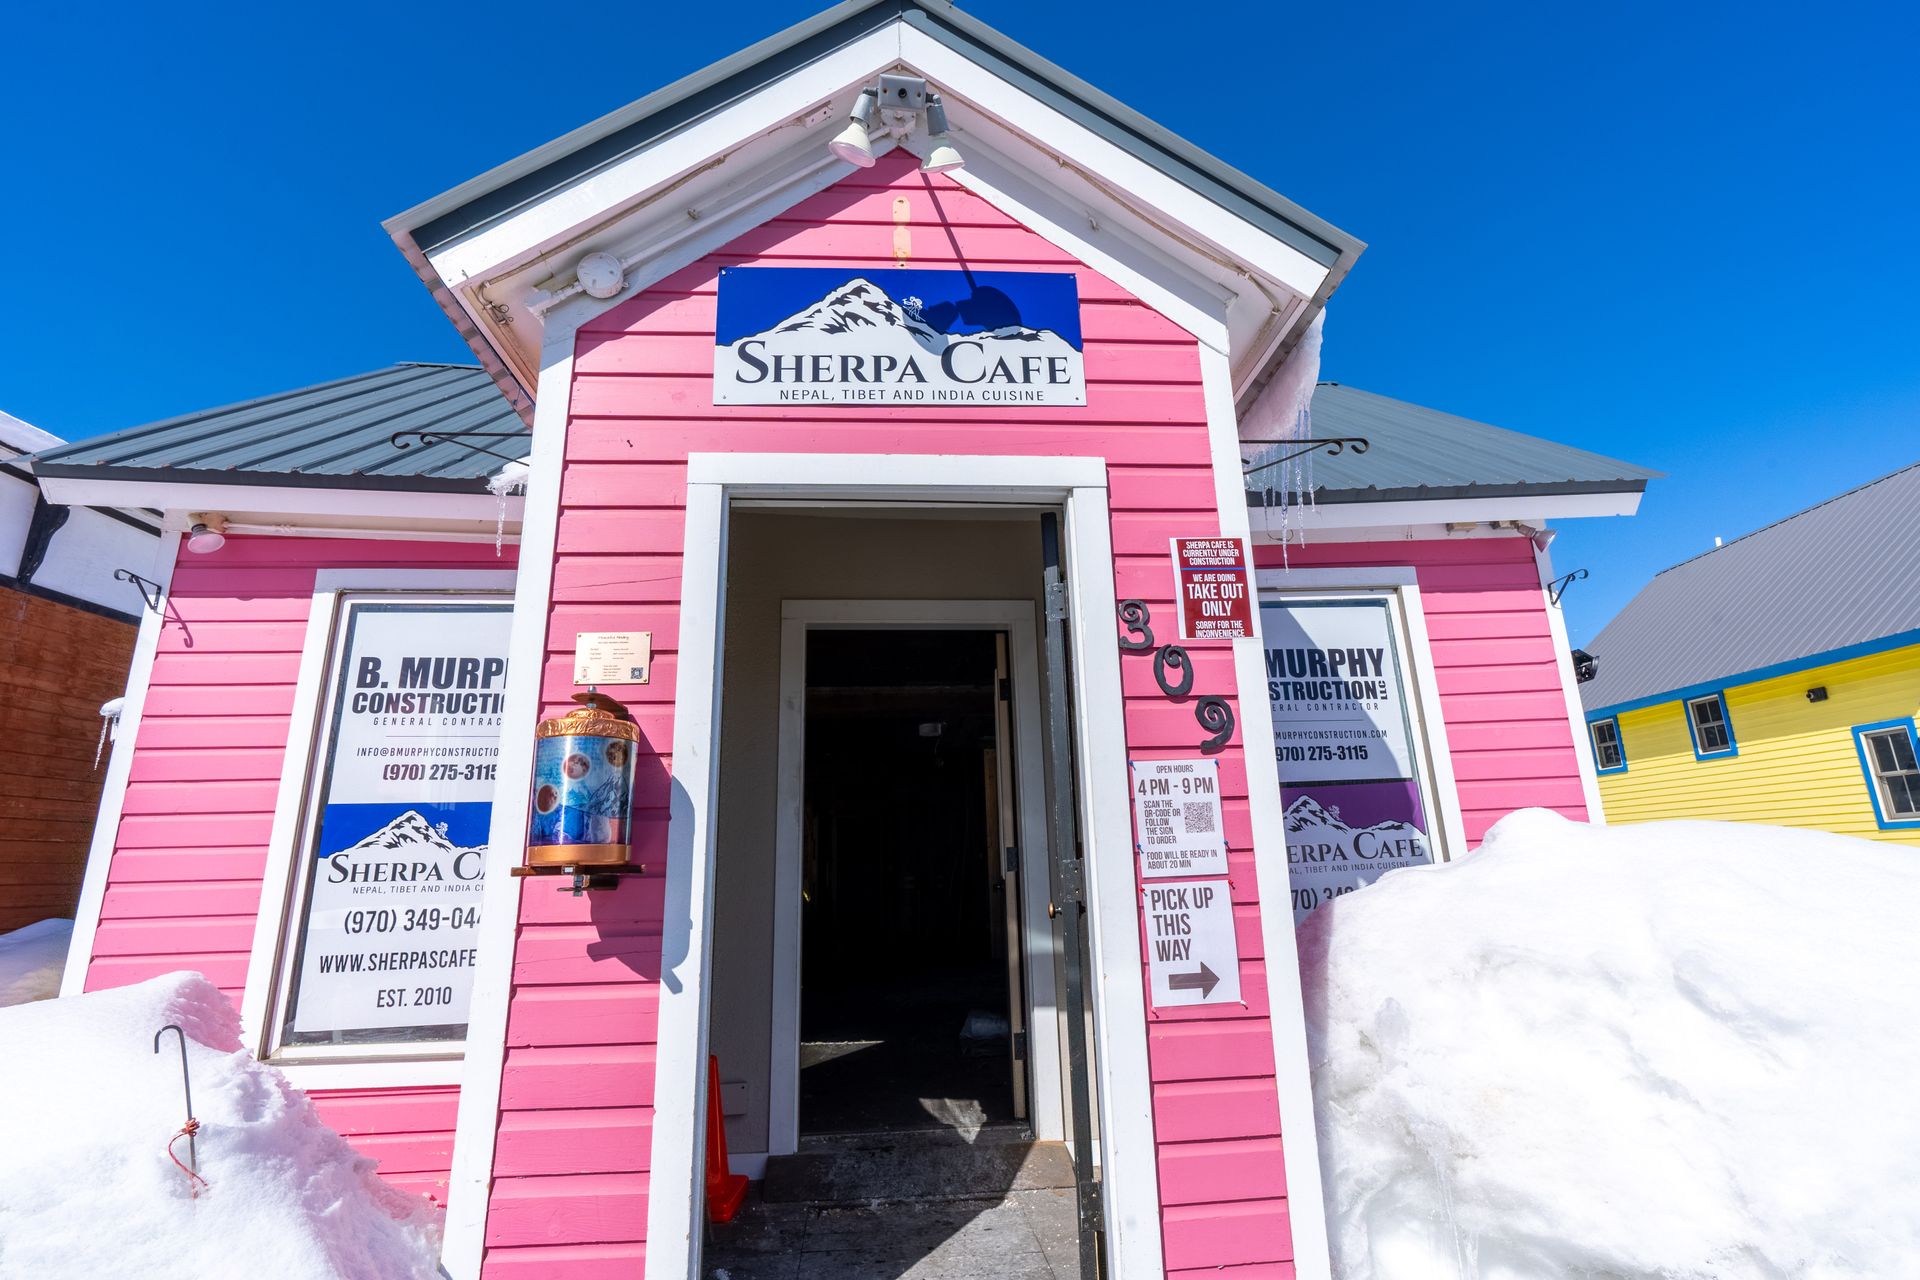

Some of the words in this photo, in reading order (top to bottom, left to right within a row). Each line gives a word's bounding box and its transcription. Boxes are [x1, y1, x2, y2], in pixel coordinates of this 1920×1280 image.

[736, 340, 929, 384] SHERPA
[940, 341, 1072, 384] CAFE
[780, 389, 835, 401] NEPAL,
[842, 389, 886, 401] TIBET
[893, 389, 925, 401] AND
[932, 389, 975, 401] INDIA
[982, 390, 1045, 401] CUISINE
[1186, 541, 1210, 549] SHERPA
[1211, 541, 1226, 549] CAFE
[1228, 540, 1234, 549] IS
[1182, 549, 1218, 558] CURRENTLY
[1218, 548, 1240, 557] UNDER
[1189, 557, 1235, 566] CONSTRUCTION
[1192, 573, 1203, 582] WE
[1204, 573, 1216, 582] ARE
[1217, 573, 1236, 582] DOING
[1187, 583, 1218, 599] TAKE
[1220, 583, 1244, 599] OUT
[1202, 600, 1233, 617] ONLY
[1195, 620, 1217, 630] SORRY
[1217, 620, 1230, 629] FOR
[1230, 620, 1243, 629] THE
[1195, 628, 1245, 638] INCONVENIENCE
[1264, 648, 1384, 678] MURPHY
[356, 656, 389, 688] B.
[398, 657, 509, 689] MURP
[1119, 600, 1235, 749] 309
[1268, 680, 1378, 701] STRUCTION
[352, 692, 505, 714] CONSTRUCTI
[1272, 703, 1299, 712] ERAL
[1307, 702, 1379, 712] CONTRACTOR
[373, 717, 433, 726] GENERAL
[1275, 730, 1388, 740] MURPHYCONSTRUCTION.COM
[1308, 745, 1368, 760] 275-3115
[383, 764, 426, 781] (970)
[428, 764, 498, 781] 275-3115
[1156, 765, 1173, 774] OPEN
[1173, 764, 1194, 773] HOURS
[1138, 779, 1147, 796] 4
[1149, 778, 1170, 796] PM
[1182, 777, 1191, 794] 9
[1194, 777, 1214, 794] PM
[1143, 800, 1160, 809] SCAN
[1161, 800, 1173, 808] THE
[1144, 809, 1171, 818] QR-CODE
[1172, 808, 1181, 817] OR
[1145, 818, 1170, 827] FOLLOW
[1146, 827, 1158, 836] THE
[1159, 826, 1174, 835] SIGN
[1147, 836, 1155, 845] TO
[1156, 835, 1177, 844] ORDER
[1353, 832, 1424, 860] CAFE
[1147, 851, 1163, 860] FOOD
[1164, 851, 1179, 860] WILL
[1180, 850, 1189, 859] BE
[1190, 849, 1209, 859] READY
[1210, 849, 1218, 858] IN
[328, 854, 444, 884] SHERPA
[1148, 860, 1168, 870] ABOUT
[1169, 860, 1178, 869] 20
[1179, 859, 1191, 868] MIN
[1305, 865, 1328, 874] TIBET
[1331, 864, 1348, 873] AND
[1351, 863, 1375, 872] INDIA
[1377, 861, 1410, 870] CUISINE
[352, 886, 387, 895] NEPAL,
[391, 885, 417, 894] TIBET
[420, 885, 441, 893] AND
[444, 884, 471, 893] INDIA
[1151, 888, 1189, 911] PICK
[1193, 887, 1214, 909] UP
[344, 909, 397, 934] (970)
[1153, 913, 1192, 936] THIS
[1156, 938, 1191, 962] WAY
[320, 949, 477, 973] WWW.SHERPASCAFE
[377, 988, 408, 1008] EST.
[414, 986, 452, 1006] 2010
